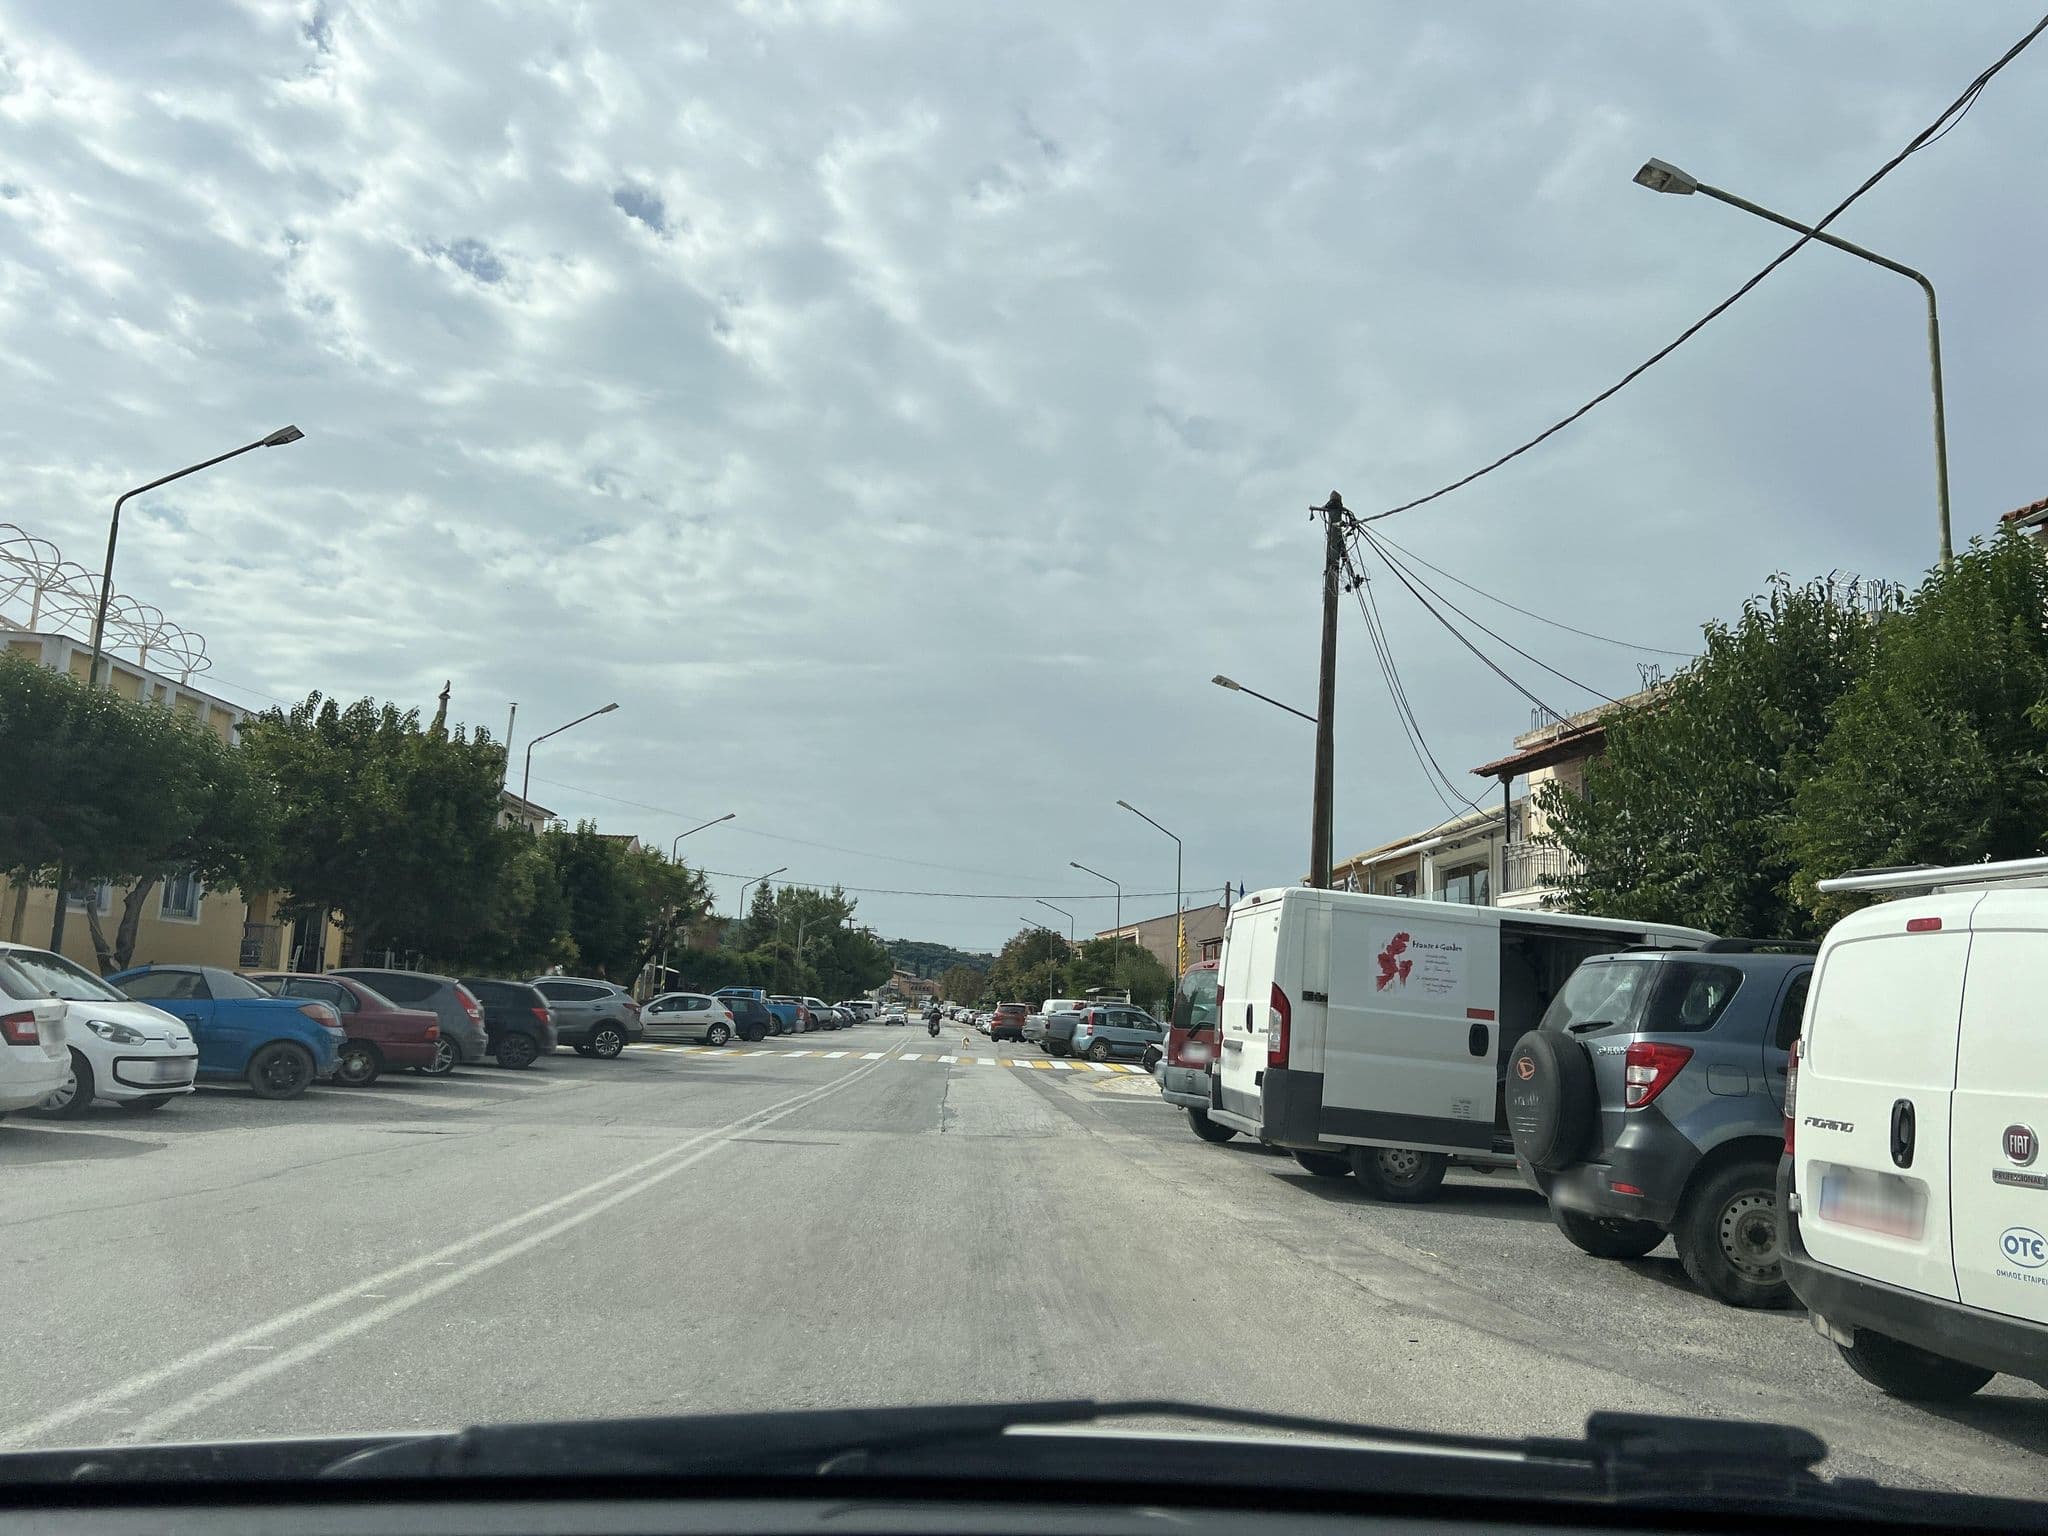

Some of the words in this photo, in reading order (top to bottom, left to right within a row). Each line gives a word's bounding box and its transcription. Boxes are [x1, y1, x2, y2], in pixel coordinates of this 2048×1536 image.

[2009, 1134, 2030, 1154] FIAT
[1994, 1170, 2042, 1185] PROFESSIONAL
[1996, 1269, 2021, 1281] ΟΜΙΛΟΣ
